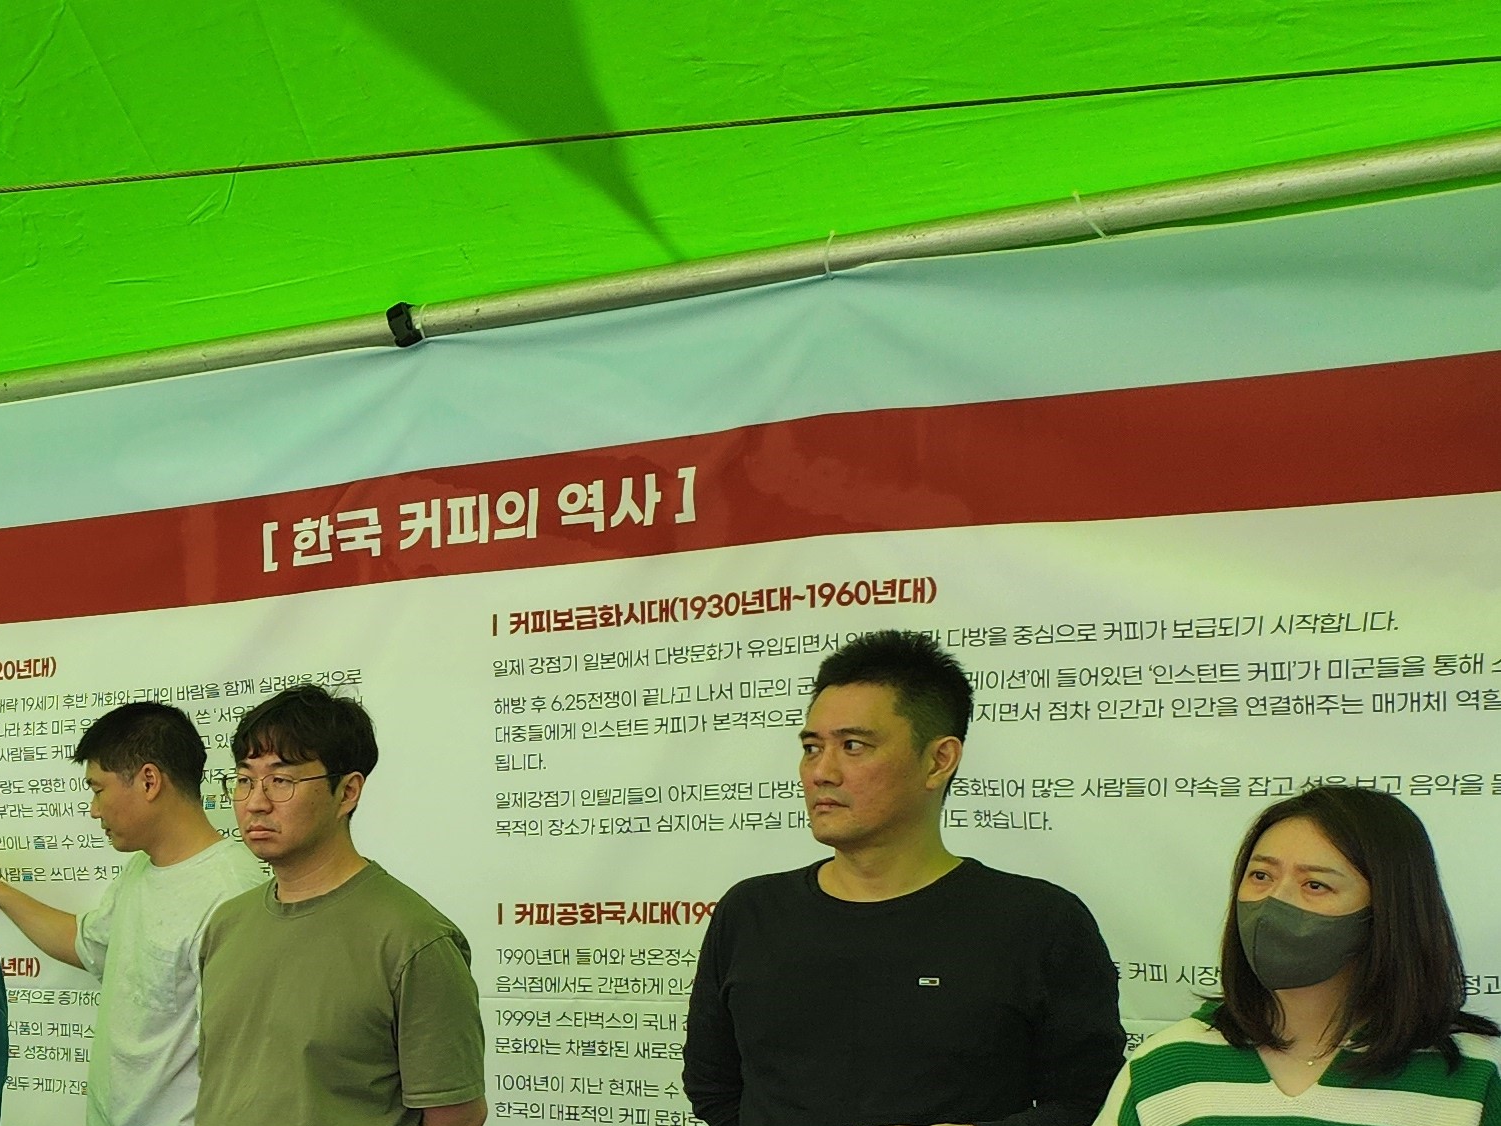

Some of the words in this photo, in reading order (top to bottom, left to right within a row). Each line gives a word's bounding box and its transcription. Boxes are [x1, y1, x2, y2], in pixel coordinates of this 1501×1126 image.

[292, 507, 382, 567] 한국
[400, 487, 539, 551] 커피의
[557, 473, 662, 533] 역사
[509, 576, 937, 635] 커피보급화시대(1930년대~1960년대)
[492, 658, 525, 678] 일제
[528, 654, 578, 675] 강점기
[583, 649, 650, 672] 일본에서
[654, 640, 742, 666] 다방문화가
[747, 632, 840, 659] 유입되면서
[947, 626, 1008, 648] 다방을
[1012, 622, 1098, 647] 중심으로
[1102, 619, 1167, 642] 커피가
[1172, 615, 1264, 639] 보급되기
[1269, 610, 1399, 635] 시작합니다.
[21, 695, 59, 712] 19세기
[63, 693, 89, 710] 후반
[91, 690, 131, 708] 개화와
[176, 683, 220, 701] 바람을
[223, 679, 255, 696] 함께
[317, 669, 363, 688] 것으로
[494, 696, 527, 715] 해방
[530, 695, 547, 714] 후
[551, 689, 638, 712] 6.25전쟁이
[642, 685, 692, 707] 끝나고
[696, 681, 734, 702] 나서
[739, 677, 792, 700] 미군의
[1055, 665, 1143, 689] 들어있던
[1328, 655, 1426, 680] 미군들을
[1432, 652, 1485, 677] 통해
[23, 720, 49, 737] 최초
[51, 718, 77, 735] 미국
[495, 722, 577, 743] 대중들에게
[581, 718, 649, 740] 인스턴트
[653, 714, 707, 735] 커피가
[712, 709, 804, 731] 본격적으로
[1048, 699, 1091, 722] 점차
[1097, 698, 1165, 720] 인간과
[1171, 696, 1239, 719] 인간을
[1245, 694, 1365, 717] 연결해주는
[1372, 690, 1448, 714] 매개체
[494, 753, 548, 772] 됩니다.
[28, 778, 66, 794] 유명한
[495, 790, 576, 810] 일제강점기
[580, 785, 663, 807] 인텔리들의
[668, 781, 754, 803] 아지트였던
[1031, 777, 1076, 799] 많은
[1081, 777, 1168, 799] 사람들이
[1174, 776, 1242, 798] 약속을
[1248, 776, 1295, 798] 잡고
[1409, 773, 1485, 796] 음악을
[37, 802, 74, 818] 곳에서
[495, 819, 543, 838] 목적의
[548, 818, 596, 837] 장소가
[599, 816, 652, 835] 되었고
[656, 813, 725, 833] 심지어는
[728, 811, 782, 831] 사무실
[973, 809, 1054, 831] 했습니다.
[33, 834, 58, 850] 즐길
[61, 834, 74, 849] 수
[77, 833, 104, 849] 있는
[49, 865, 90, 882] 쓰디쓴
[93, 865, 107, 881] 첫
[495, 948, 571, 967] 1990년대
[575, 947, 625, 967] 들어와
[1128, 962, 1168, 984] 커피
[495, 975, 593, 994] 음식점에서도
[597, 976, 664, 996] 간편하게
[495, 1009, 552, 1028] 1999년
[555, 1011, 639, 1030] 스타벅스의
[641, 1013, 678, 1032] 국내
[23, 1045, 72, 1062] 성장하게
[494, 1037, 562, 1056] 문화와는
[565, 1039, 630, 1059] 차별화된
[32, 1077, 67, 1094] 커피가
[494, 1074, 564, 1094] 10여년이
[569, 1076, 604, 1096] 지난
[608, 1078, 660, 1098] 현재는
[494, 1101, 546, 1120] 한국의
[549, 1104, 614, 1125] 대표적인
[618, 1107, 651, 1126] 커피
